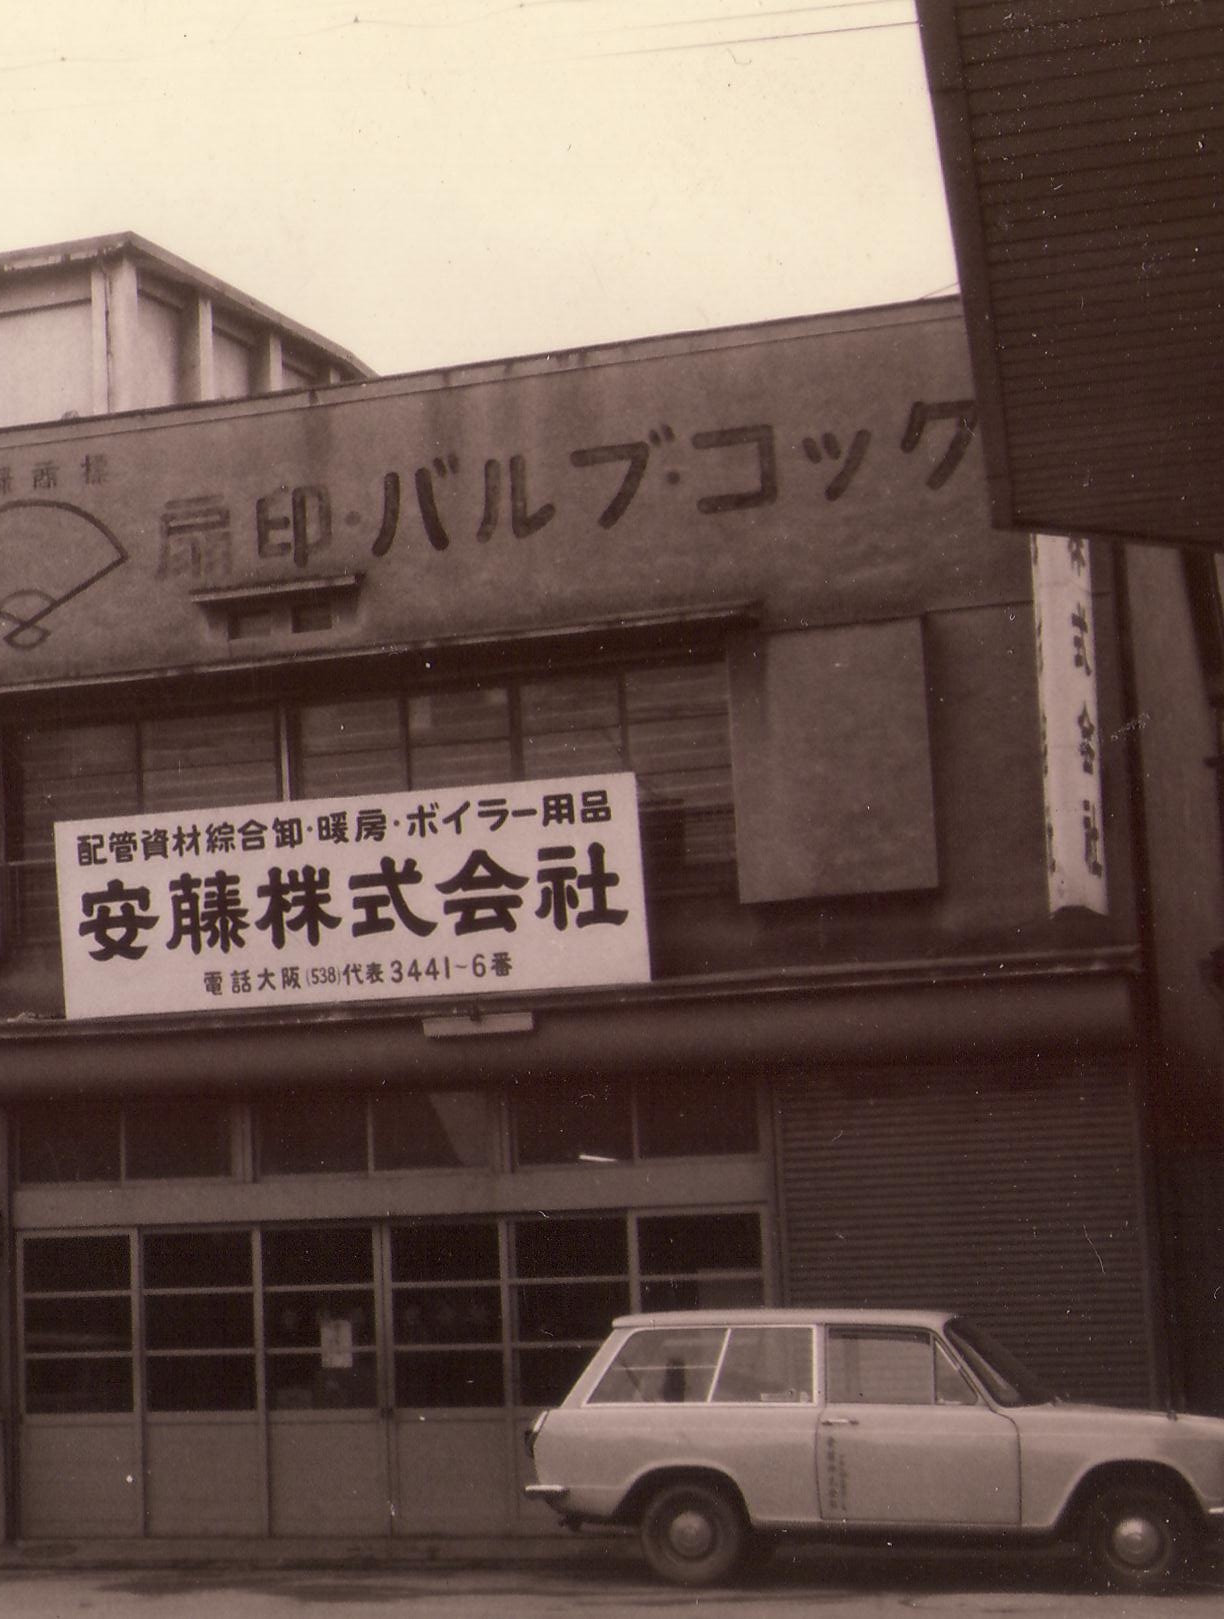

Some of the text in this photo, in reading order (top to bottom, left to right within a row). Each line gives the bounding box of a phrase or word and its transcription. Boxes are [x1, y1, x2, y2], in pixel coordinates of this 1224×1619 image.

[78, 841, 629, 961] 安藤株式会社
